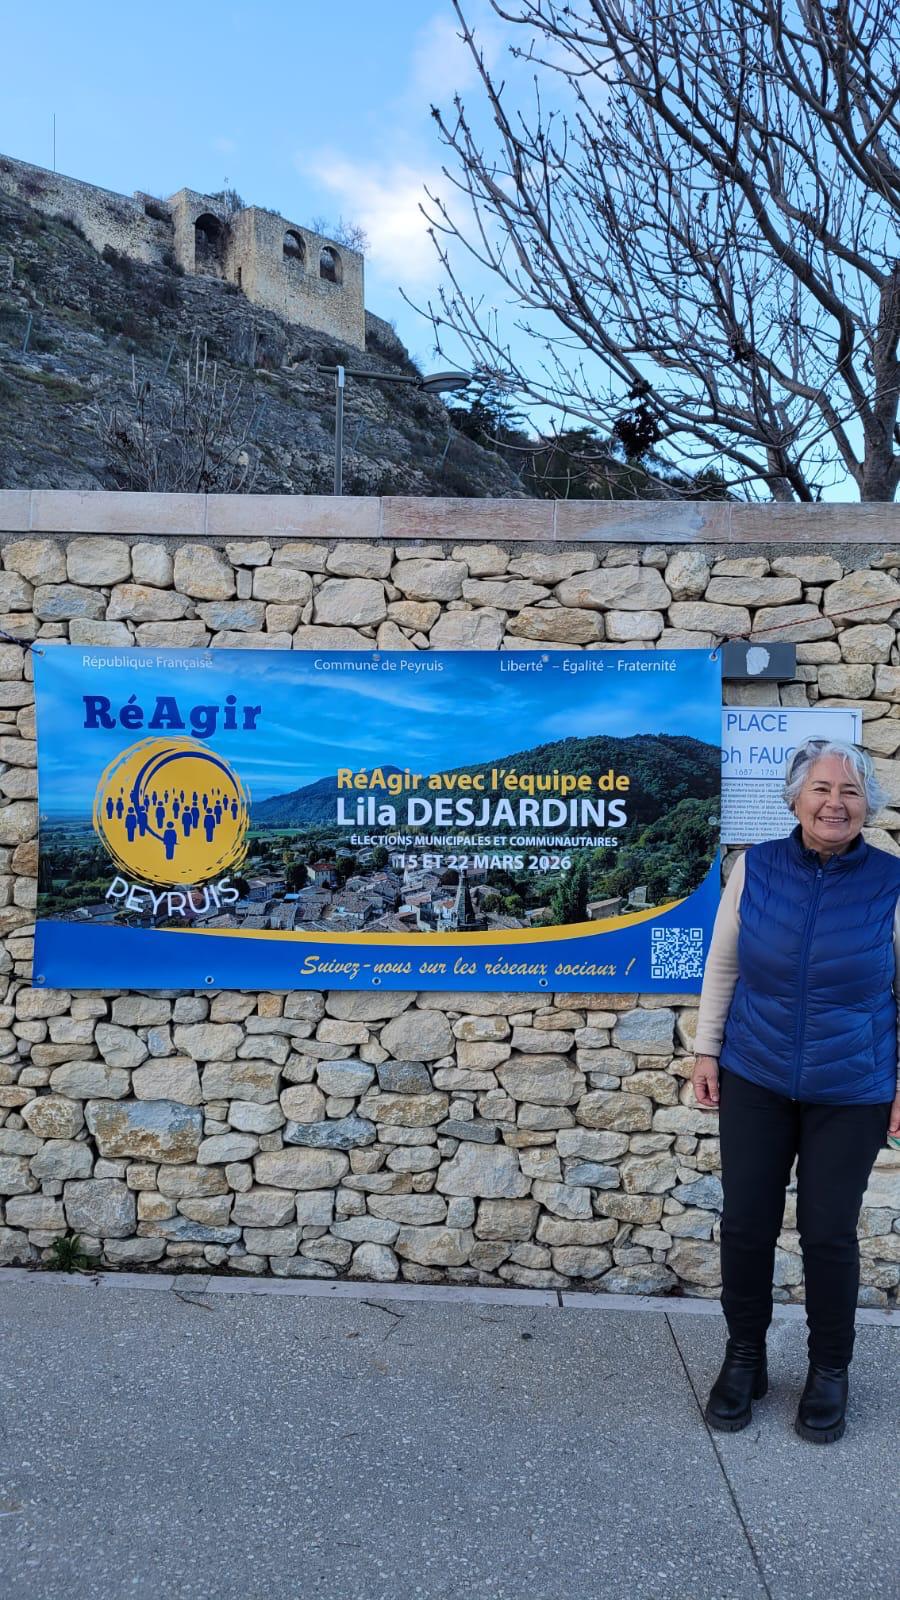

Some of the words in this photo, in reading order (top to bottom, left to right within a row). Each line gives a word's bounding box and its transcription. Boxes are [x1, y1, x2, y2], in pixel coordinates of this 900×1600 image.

[82, 655, 153, 670] République
[156, 656, 213, 671] Française
[314, 659, 378, 671] Commune
[381, 659, 397, 671] de
[400, 660, 444, 674] Peyruis
[500, 659, 543, 672] Liberté
[563, 658, 604, 674] Égalité
[617, 659, 677, 672] Fraternité
[82, 694, 262, 739] RéAgir
[727, 714, 788, 732] PLACE
[337, 767, 422, 796] RéAgir
[428, 773, 485, 790] avec
[598, 769, 630, 791] de
[337, 796, 396, 826] Lila
[407, 798, 627, 828] DESJARDINS
[350, 833, 412, 846] ÉLECTIONS
[415, 835, 491, 846] MUNICIPALES
[493, 836, 507, 846] ET
[509, 836, 618, 847] COMMUNAUTAIRES
[397, 854, 418, 869] 15
[422, 855, 443, 869] ET
[447, 855, 469, 870] 22
[473, 855, 524, 870] MARS
[528, 855, 572, 870] 2026
[105, 876, 239, 917] PEYRUIS
[419, 961, 447, 974] sur
[453, 957, 478, 975] les
[484, 957, 547, 976] réseaux
[554, 961, 616, 976] sociaux
